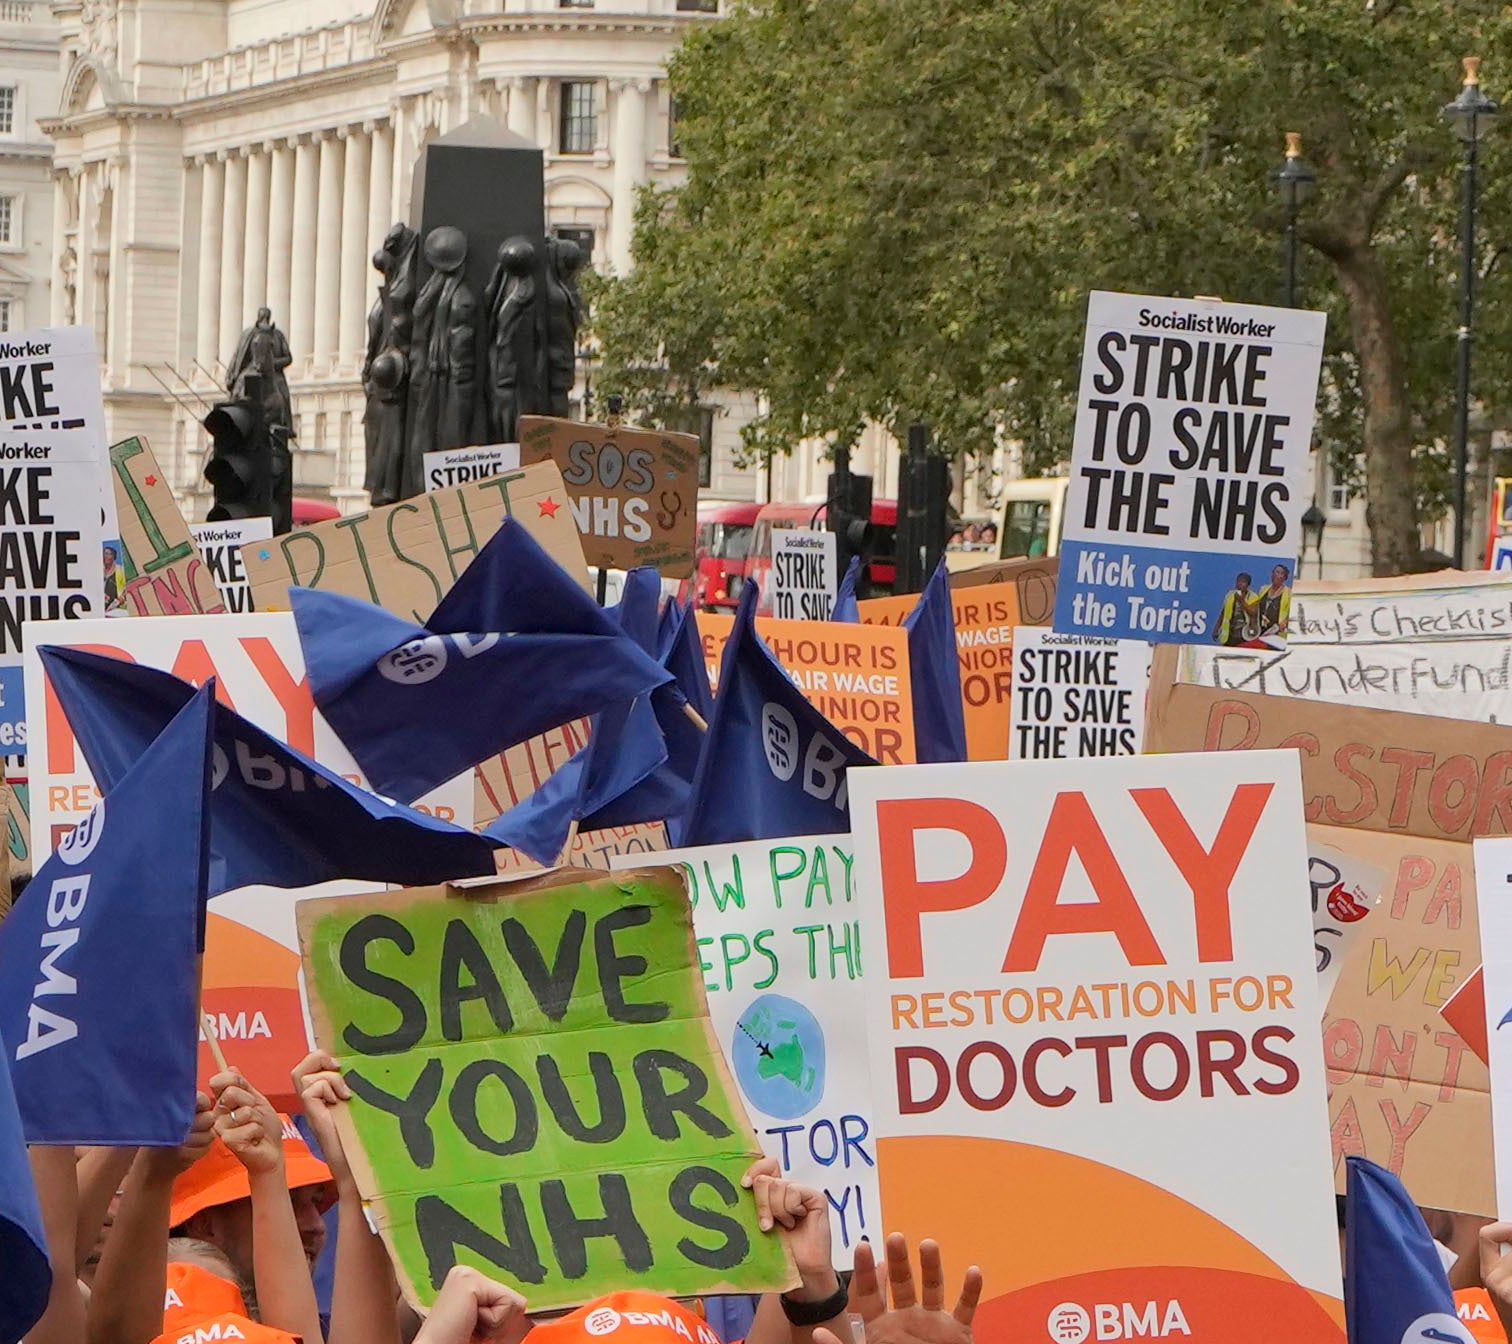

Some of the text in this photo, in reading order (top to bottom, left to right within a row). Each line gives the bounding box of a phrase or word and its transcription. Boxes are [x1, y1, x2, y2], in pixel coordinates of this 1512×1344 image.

[1093, 331, 1273, 407] STRIKE
[1088, 399, 1290, 476] TO SAVE
[563, 440, 655, 494] SOS
[1081, 467, 1290, 544] THE NHS
[775, 552, 827, 590] STRIKE
[1077, 550, 1191, 593] Kick out
[776, 592, 833, 621] TO SAVE
[985, 601, 1008, 622] IS
[1072, 593, 1208, 635] the Tories
[871, 646, 897, 669] IS
[956, 626, 1012, 648] WAGE
[833, 671, 899, 696] WAGE
[1020, 648, 1119, 685] STRIKE
[1018, 687, 1133, 724] TO SAVE
[1016, 725, 1136, 756] THE NHS
[770, 846, 855, 908] PAY
[877, 782, 1275, 980] PAY
[15, 873, 92, 1061] BMA
[339, 905, 672, 1055] SAVE
[1367, 937, 1461, 1007] WE
[891, 975, 1294, 1030] RESTORATION FOR
[199, 1011, 272, 1041] BMA
[895, 1026, 1299, 1115] DOCTORS
[343, 1048, 734, 1170] YOUR
[414, 1166, 751, 1292] NHS
[621, 1309, 694, 1342] BMA
[1095, 1299, 1192, 1340] BMA
